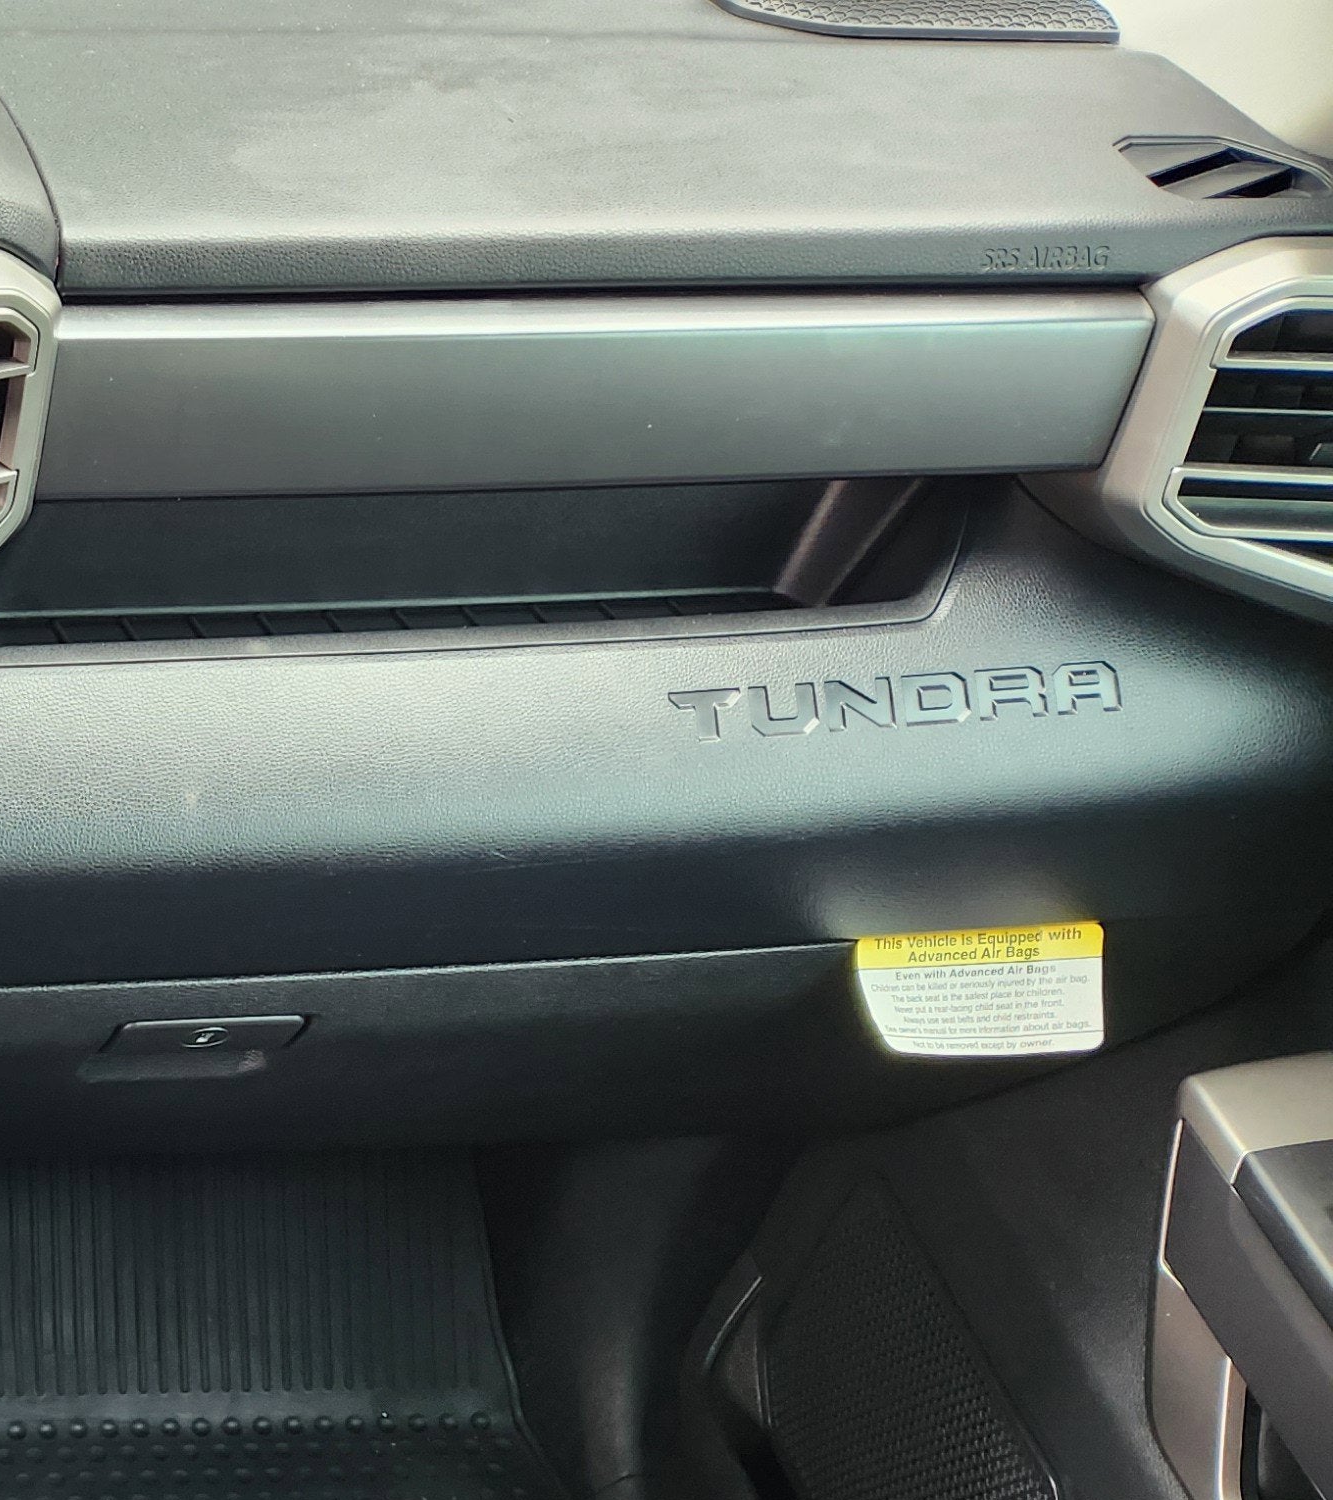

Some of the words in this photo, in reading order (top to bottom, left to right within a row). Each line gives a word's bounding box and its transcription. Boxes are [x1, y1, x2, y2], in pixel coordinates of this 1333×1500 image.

[981, 247, 1021, 271] SRS
[1025, 245, 1110, 271] AIRBAG
[667, 660, 1123, 742] TUNDRA
[874, 937, 902, 950] This
[907, 935, 957, 949] Vehicle
[977, 930, 1044, 948] Equipped
[1048, 927, 1082, 940] with
[908, 948, 977, 963] Advanced
[981, 947, 1001, 960] Air
[1006, 946, 1040, 960] Bags
[895, 971, 921, 981] Even
[924, 969, 946, 979] with
[949, 966, 1004, 978] Advanced
[1007, 966, 1023, 976] Air
[1026, 964, 1057, 976] Bags
[902, 984, 915, 992] can
[916, 982, 926, 991] be
[928, 981, 947, 990] killed
[960, 980, 995, 990] seriously
[997, 978, 1025, 988] injured
[1026, 977, 1036, 987] by
[1039, 976, 1053, 985] the
[1055, 975, 1067, 983] air
[906, 993, 923, 1002] back
[925, 993, 940, 1002] seat
[951, 991, 963, 1000] the
[991, 989, 1012, 1000] place
[1014, 988, 1025, 998] for
[975, 1002, 993, 1011] child
[996, 1001, 1013, 1010] seat
[1015, 1000, 1022, 1009] in
[1024, 999, 1038, 1009] the
[976, 1014, 990, 1022] and
[993, 1012, 1011, 1021] child
[979, 1024, 1020, 1033] information
[1023, 1022, 1049, 1032] about
[1052, 1021, 1064, 1030] air
[927, 1040, 934, 1048] to
[935, 1040, 944, 1049] be
[946, 1040, 978, 1049] removed
[1007, 1039, 1017, 1049] by
